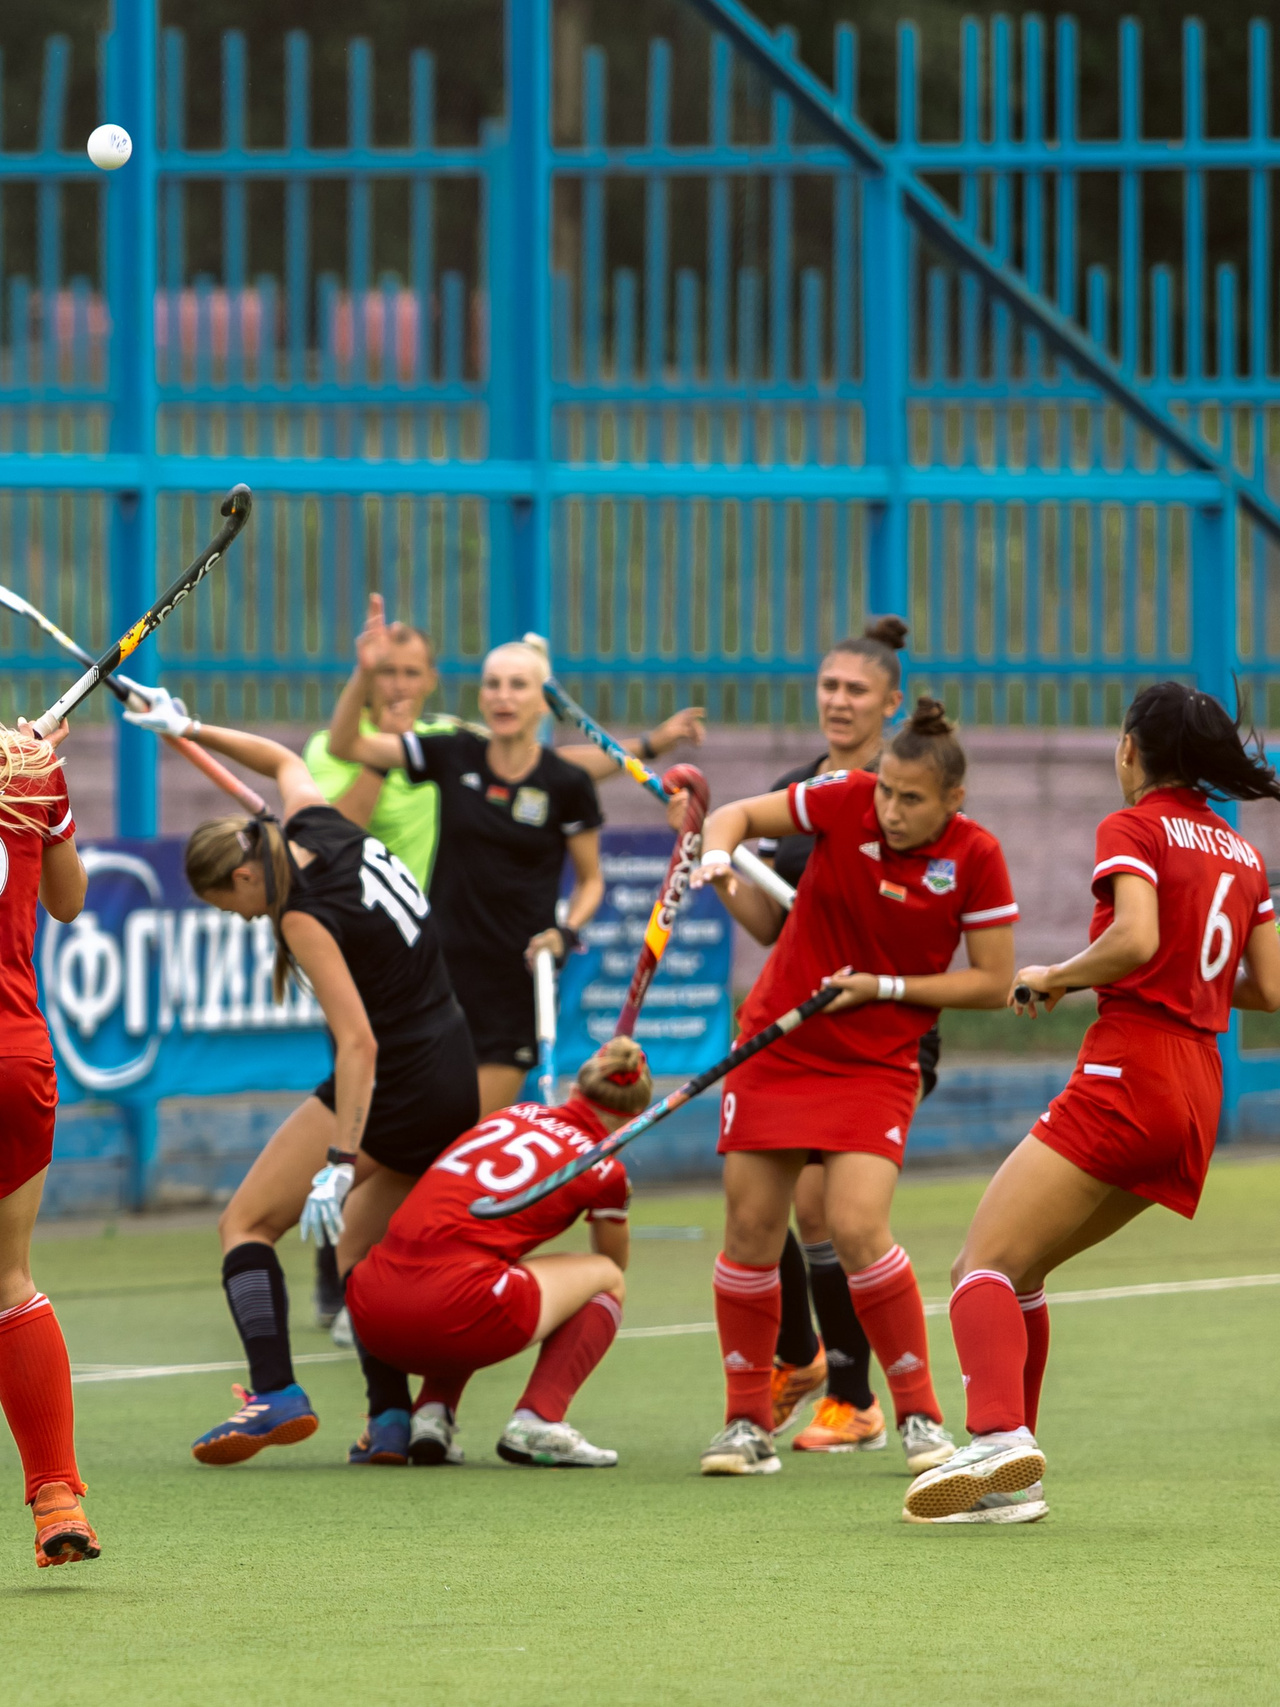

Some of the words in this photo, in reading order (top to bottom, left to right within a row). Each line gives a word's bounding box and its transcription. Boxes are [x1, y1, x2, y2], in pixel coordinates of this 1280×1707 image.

[1200, 871, 1236, 983] 6
[723, 1091, 737, 1135] 9
[434, 1117, 564, 1193] 25
